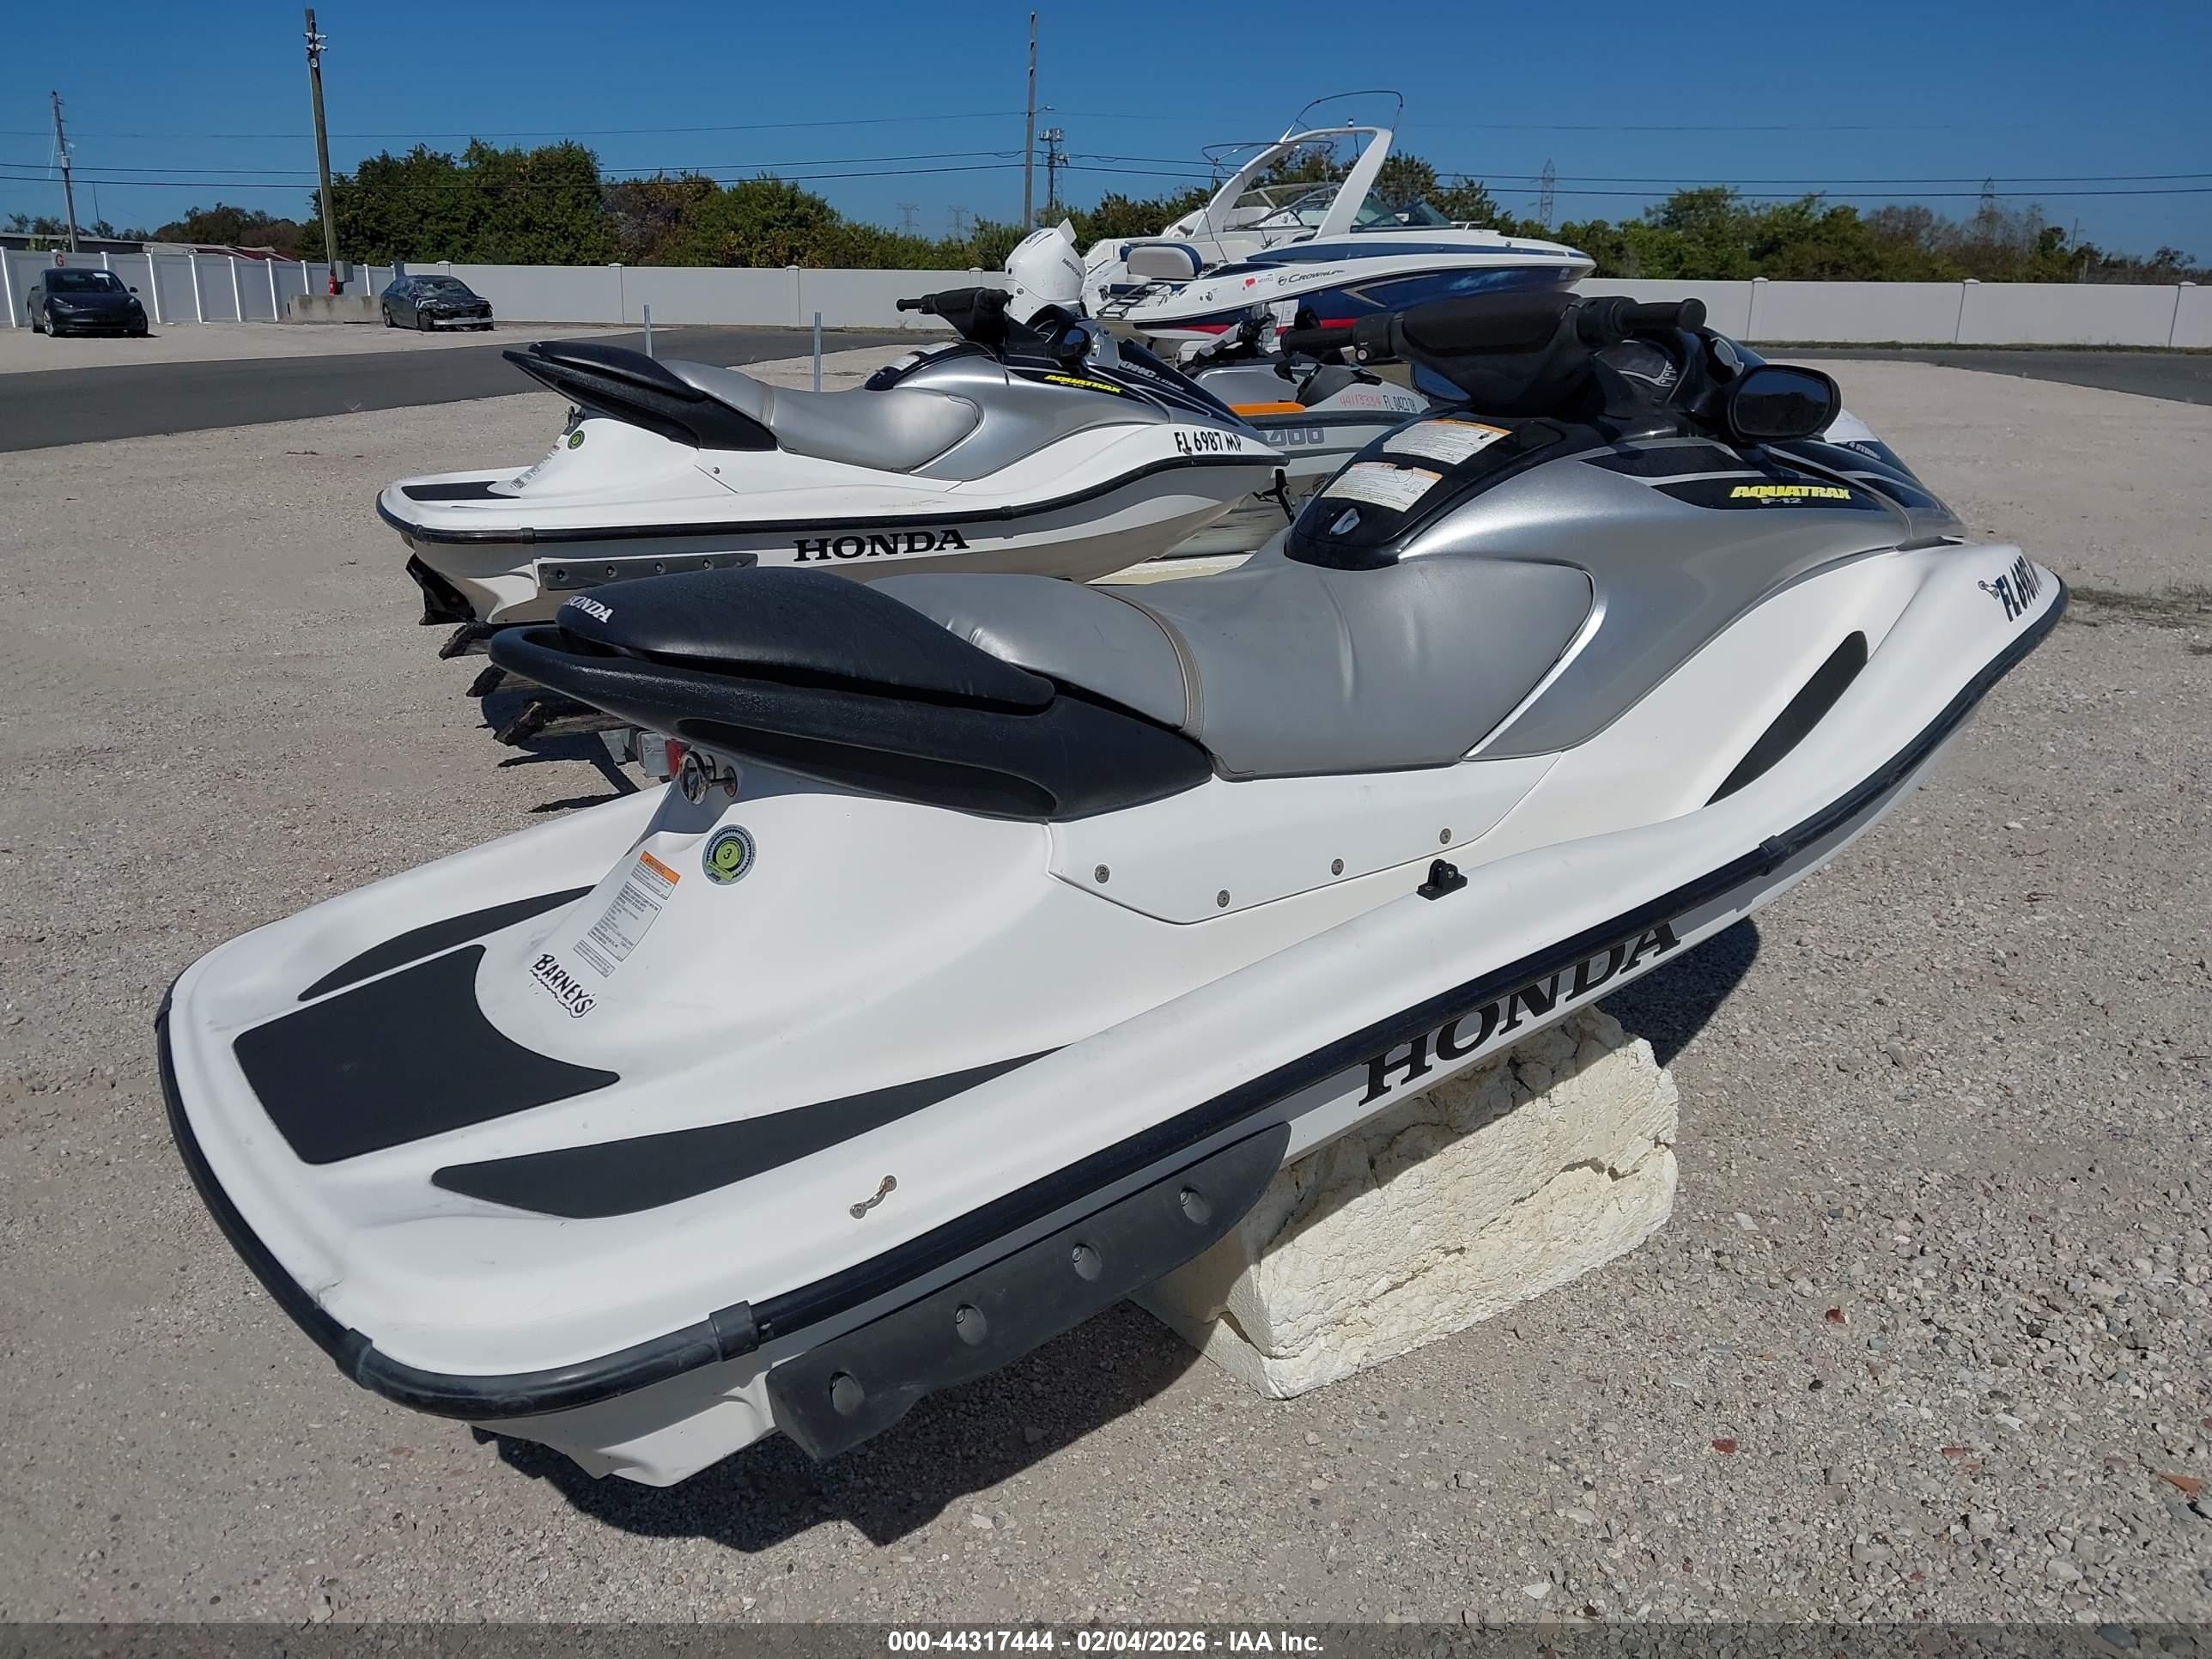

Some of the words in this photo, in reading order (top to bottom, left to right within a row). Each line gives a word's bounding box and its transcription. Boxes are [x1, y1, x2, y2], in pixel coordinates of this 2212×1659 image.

[55, 253, 64, 267] G
[1044, 374, 1123, 393] AQUATRAX
[1174, 431, 1193, 453] FL
[1194, 430, 1224, 453] 6987
[1729, 485, 1852, 500] AQUATRAX
[793, 528, 970, 562] HONDA
[1995, 574, 2023, 623] FL
[723, 848, 732, 860] 3
[1358, 922, 1682, 1108] HONDA
